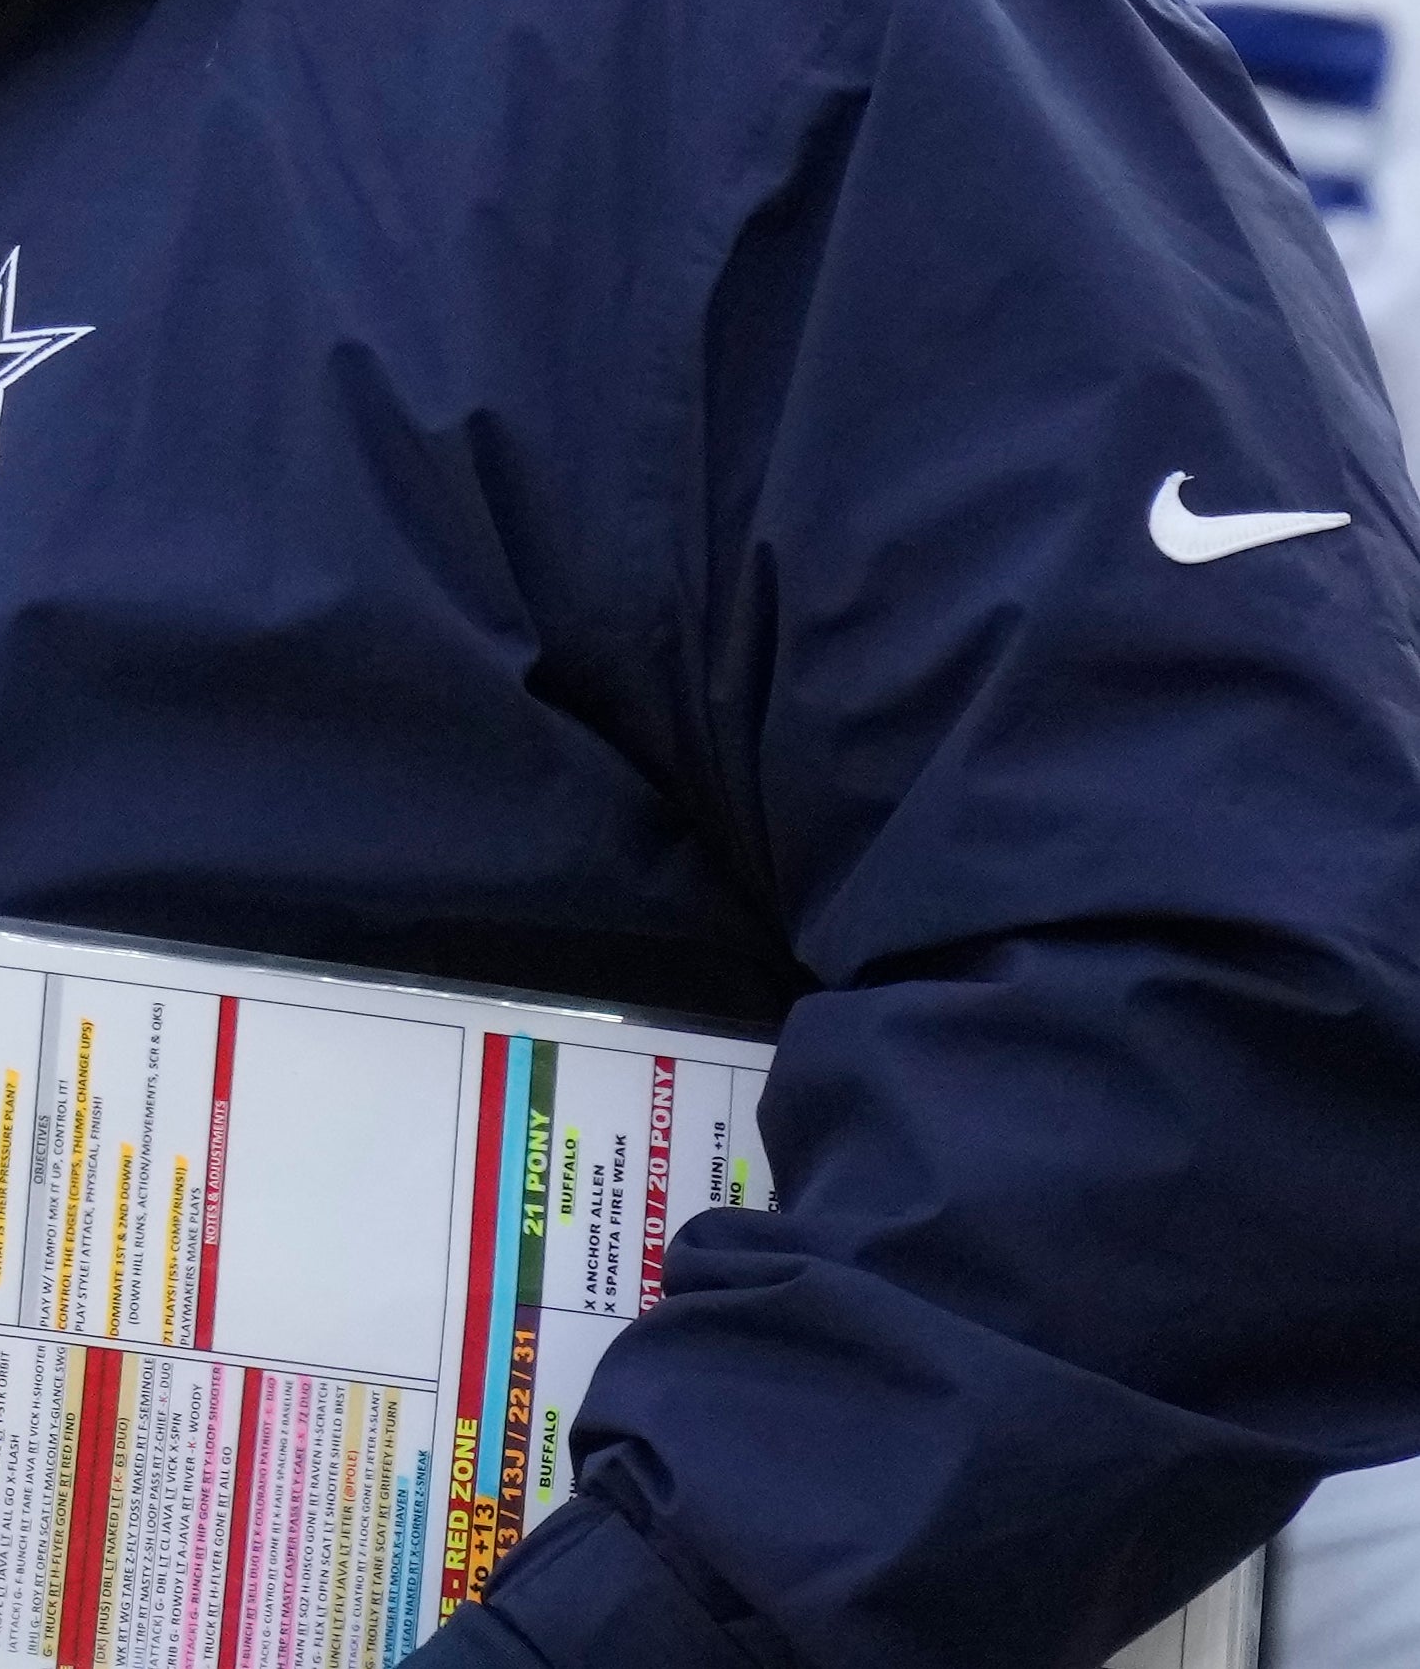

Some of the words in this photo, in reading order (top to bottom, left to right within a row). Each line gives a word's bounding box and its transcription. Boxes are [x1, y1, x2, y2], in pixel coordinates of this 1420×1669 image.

[650, 1065, 674, 1147] PONY
[207, 1100, 227, 1190] ADJUSTMENTS
[526, 1109, 550, 1191] PONY
[612, 1134, 627, 1183] WEAK
[711, 1121, 727, 1150] +18
[559, 1138, 577, 1214] BUFFALO
[589, 1164, 605, 1217] ALLEN
[647, 1156, 668, 1192] 20
[708, 1155, 724, 1201] SHIN)
[203, 1204, 219, 1244] NOTES
[523, 1203, 544, 1236] 21
[609, 1188, 624, 1225] FIRE
[643, 1216, 664, 1251] 10
[584, 1223, 601, 1293] ANCHOR
[604, 1230, 621, 1295] SPARTA
[583, 1299, 596, 1311] X
[603, 1301, 616, 1314] X
[639, 1278, 660, 1311] 01
[513, 1330, 534, 1362] 31
[508, 1387, 530, 1423] 22
[451, 1417, 477, 1501] ZONE
[539, 1410, 557, 1487] BUFFALO
[503, 1448, 525, 1501] 13J
[445, 1509, 469, 1570] RED
